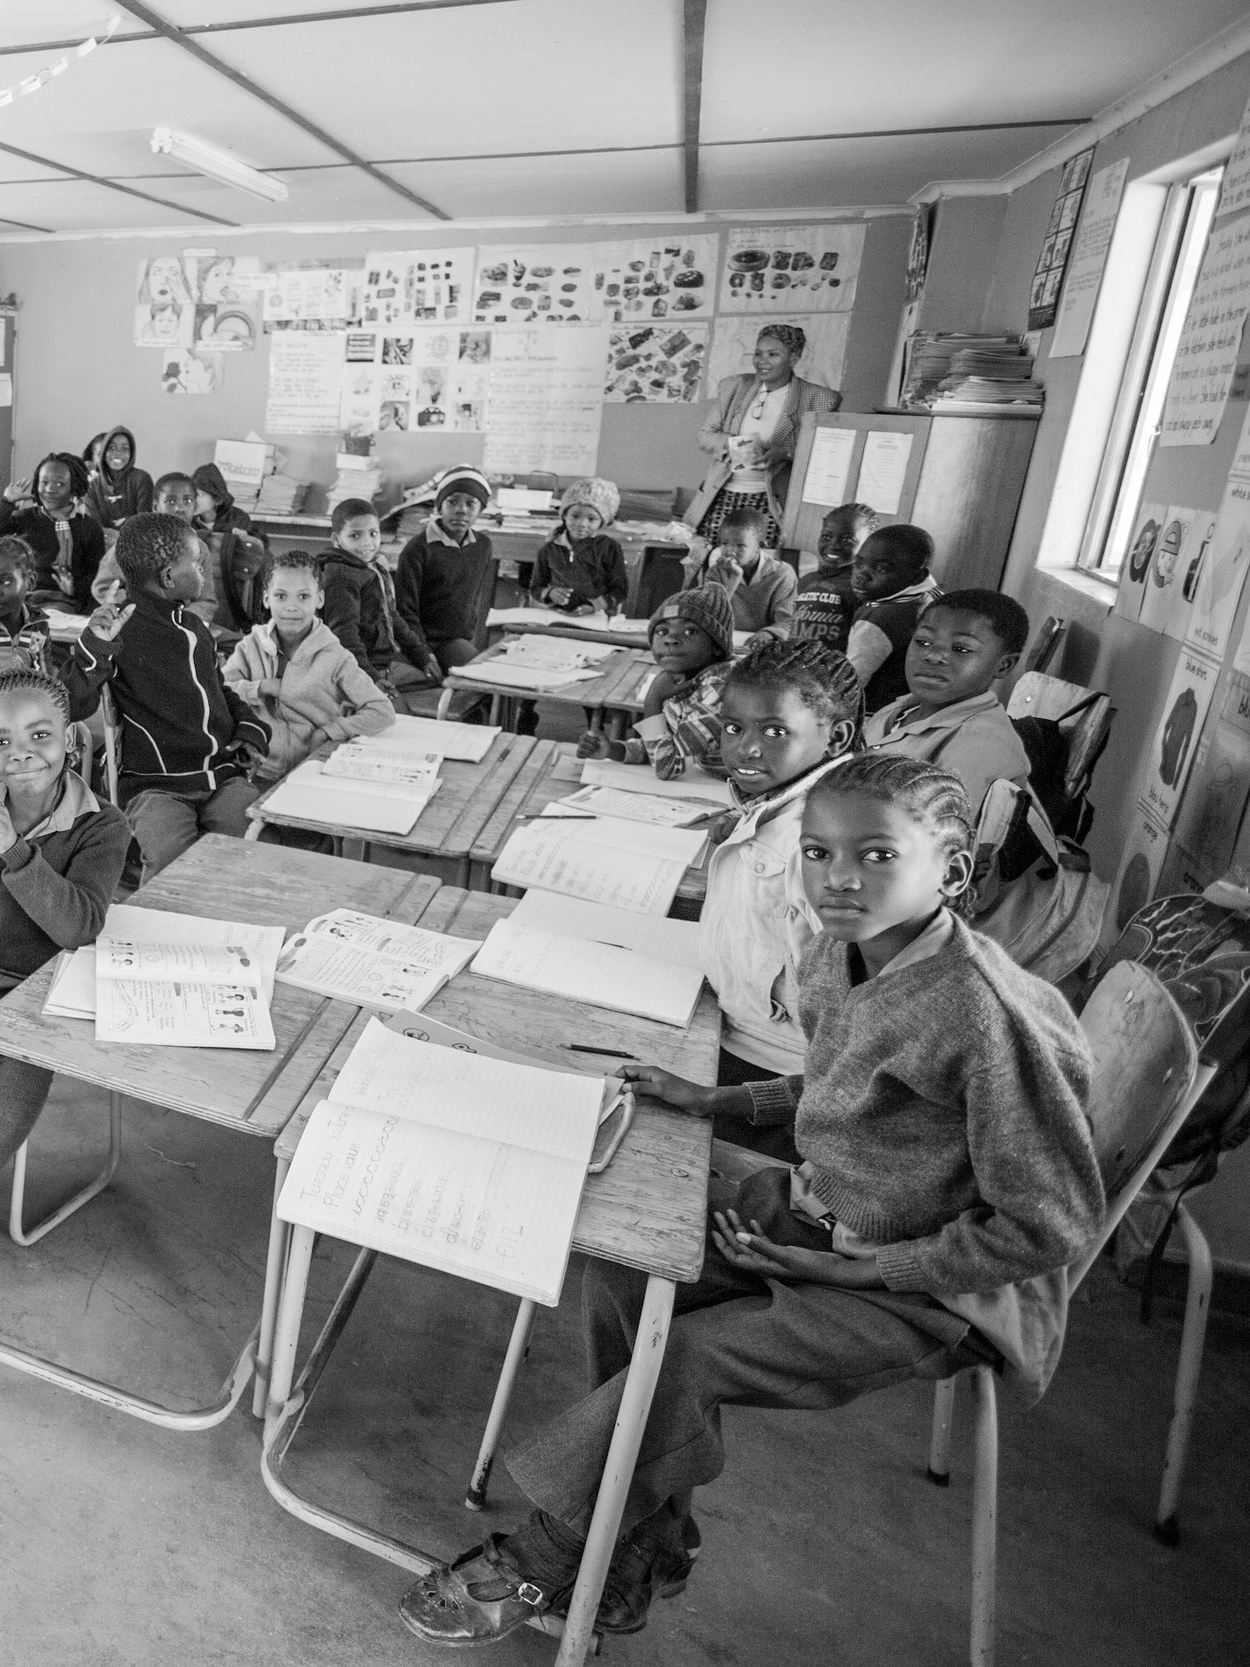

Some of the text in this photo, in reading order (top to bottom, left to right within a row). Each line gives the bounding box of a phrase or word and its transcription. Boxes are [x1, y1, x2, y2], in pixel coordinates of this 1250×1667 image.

[819, 592, 841, 605] CLUB
[790, 622, 840, 641] AMPS
[300, 1151, 340, 1200] Tuesday
[323, 1173, 350, 1207] Place
